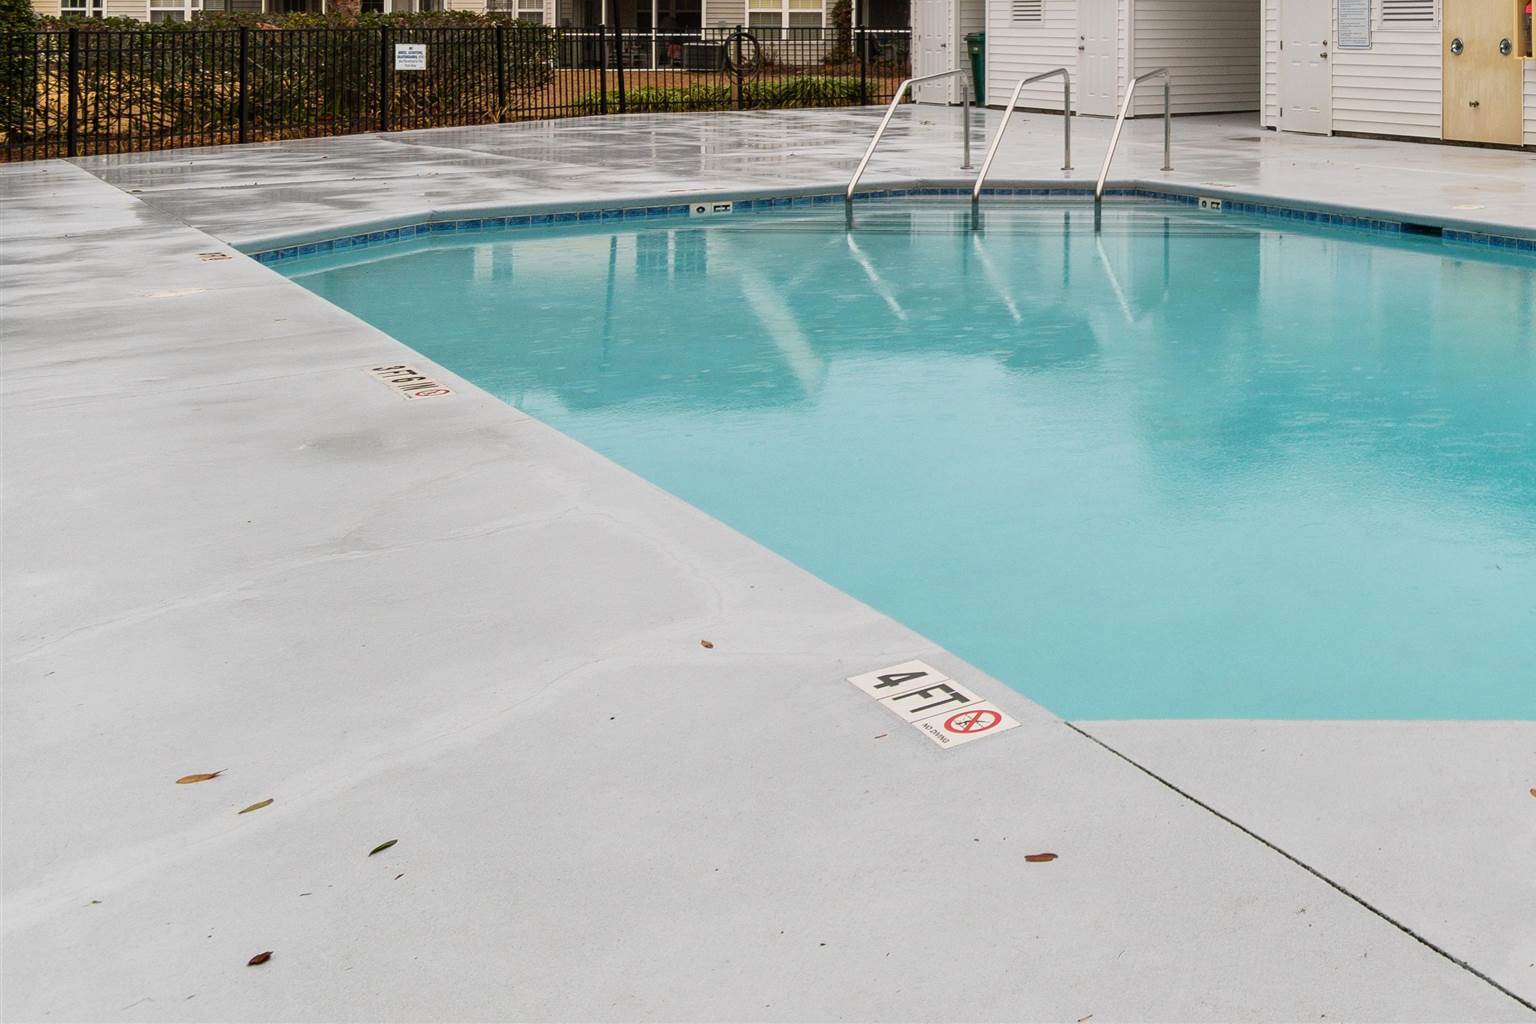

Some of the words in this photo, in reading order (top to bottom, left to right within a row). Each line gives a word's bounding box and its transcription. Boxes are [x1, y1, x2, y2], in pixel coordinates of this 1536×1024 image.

[873, 670, 929, 690] 4
[892, 683, 971, 714] FT
[921, 722, 933, 731] NO
